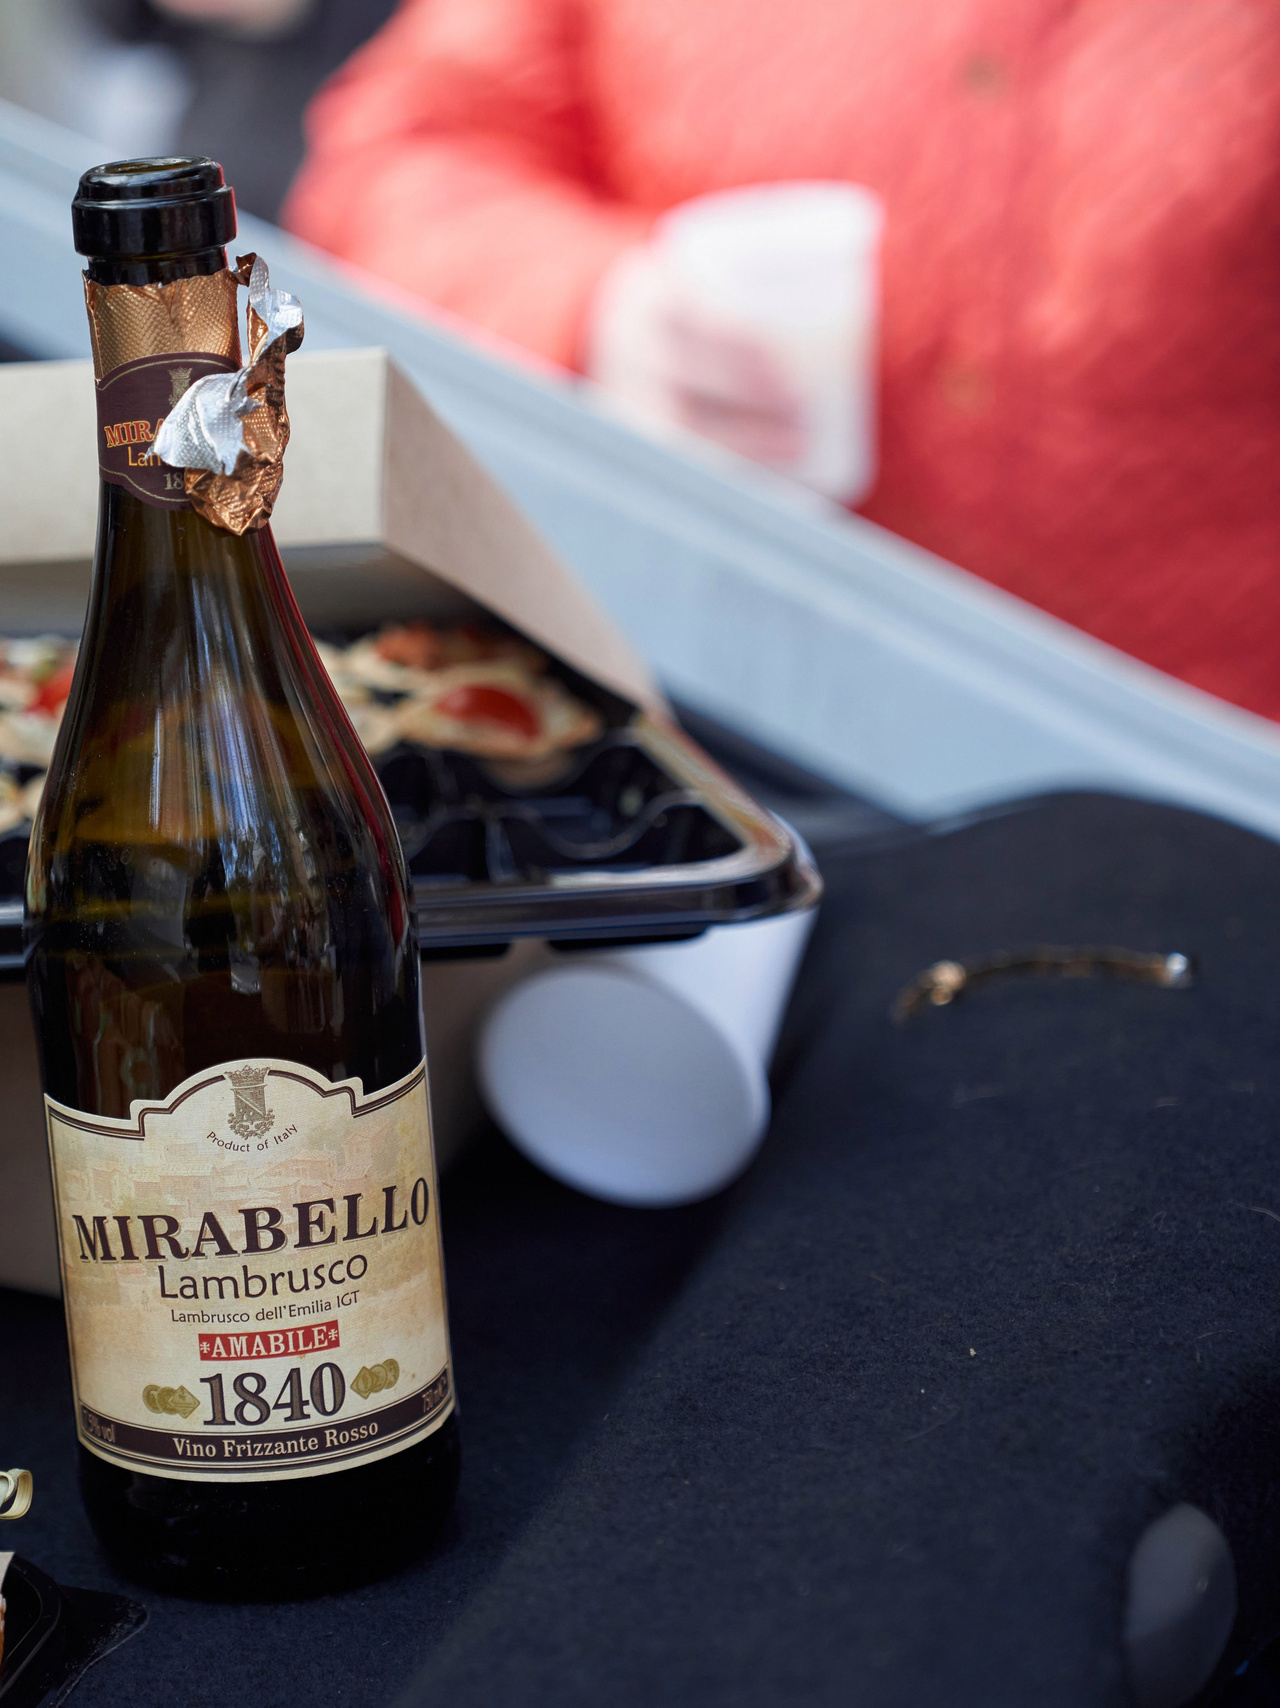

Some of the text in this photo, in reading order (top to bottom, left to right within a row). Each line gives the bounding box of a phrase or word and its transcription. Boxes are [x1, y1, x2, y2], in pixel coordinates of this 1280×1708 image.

[206, 1124, 298, 1152] Product of Italy
[72, 1177, 430, 1262] MIRABELLO
[158, 1254, 368, 1300] Lambrusco
[171, 1309, 250, 1323] Lambrusco
[336, 1290, 360, 1308] IGT
[211, 1325, 328, 1358] AMABILE
[199, 1362, 346, 1426] 1840
[172, 1422, 379, 1458] Vino Frizzante Rosso
